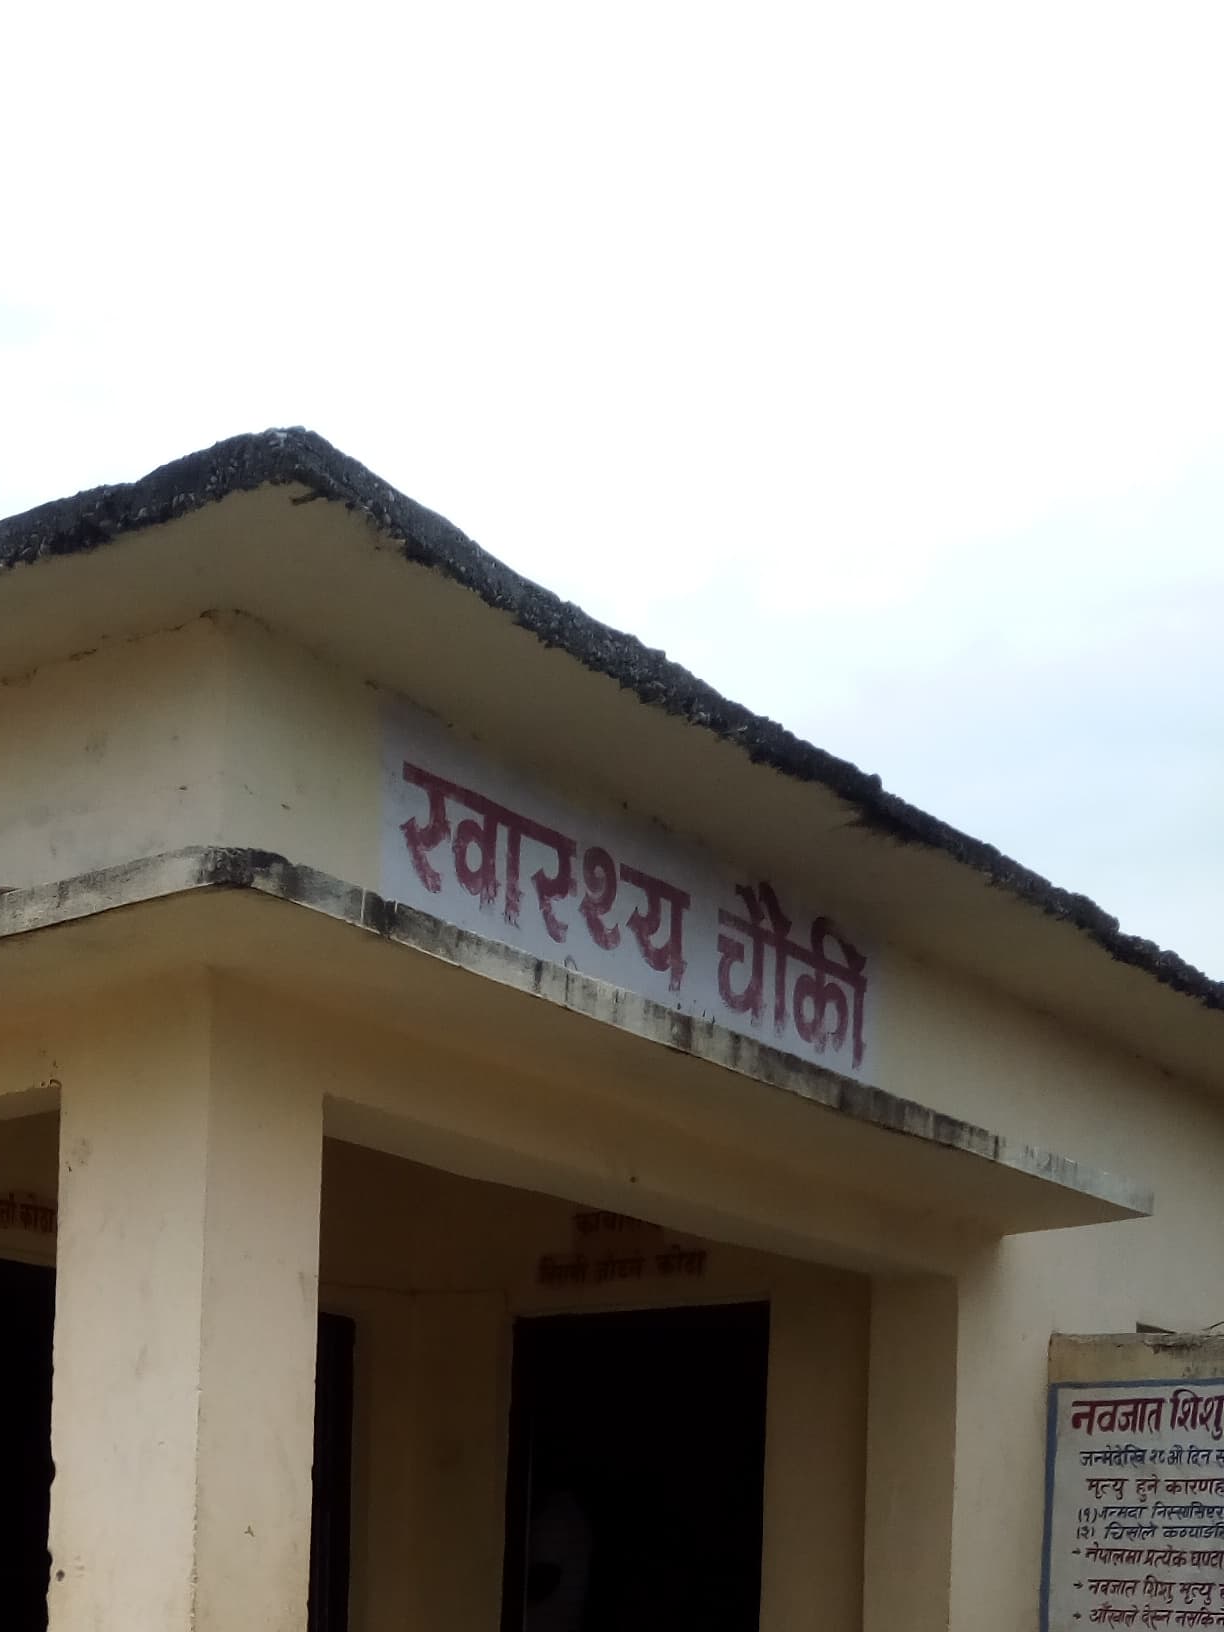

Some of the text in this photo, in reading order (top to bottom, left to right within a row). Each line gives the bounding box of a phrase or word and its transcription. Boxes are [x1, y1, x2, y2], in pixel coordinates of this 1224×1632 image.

[399, 761, 868, 1070] स्वास्थ्य चौकी
[1071, 1397, 1166, 1436] नवजात
[1085, 1478, 1128, 1500] मृत्यु
[1136, 1474, 1160, 1502] हुने
[1085, 1542, 1144, 1566] नेपालमा
[1144, 1545, 1188, 1567] प्रत्येक
[1088, 1578, 1141, 1597] नवजात
[1143, 1575, 1176, 1604] शिशु
[1179, 1582, 1216, 1605] मृत्यु
